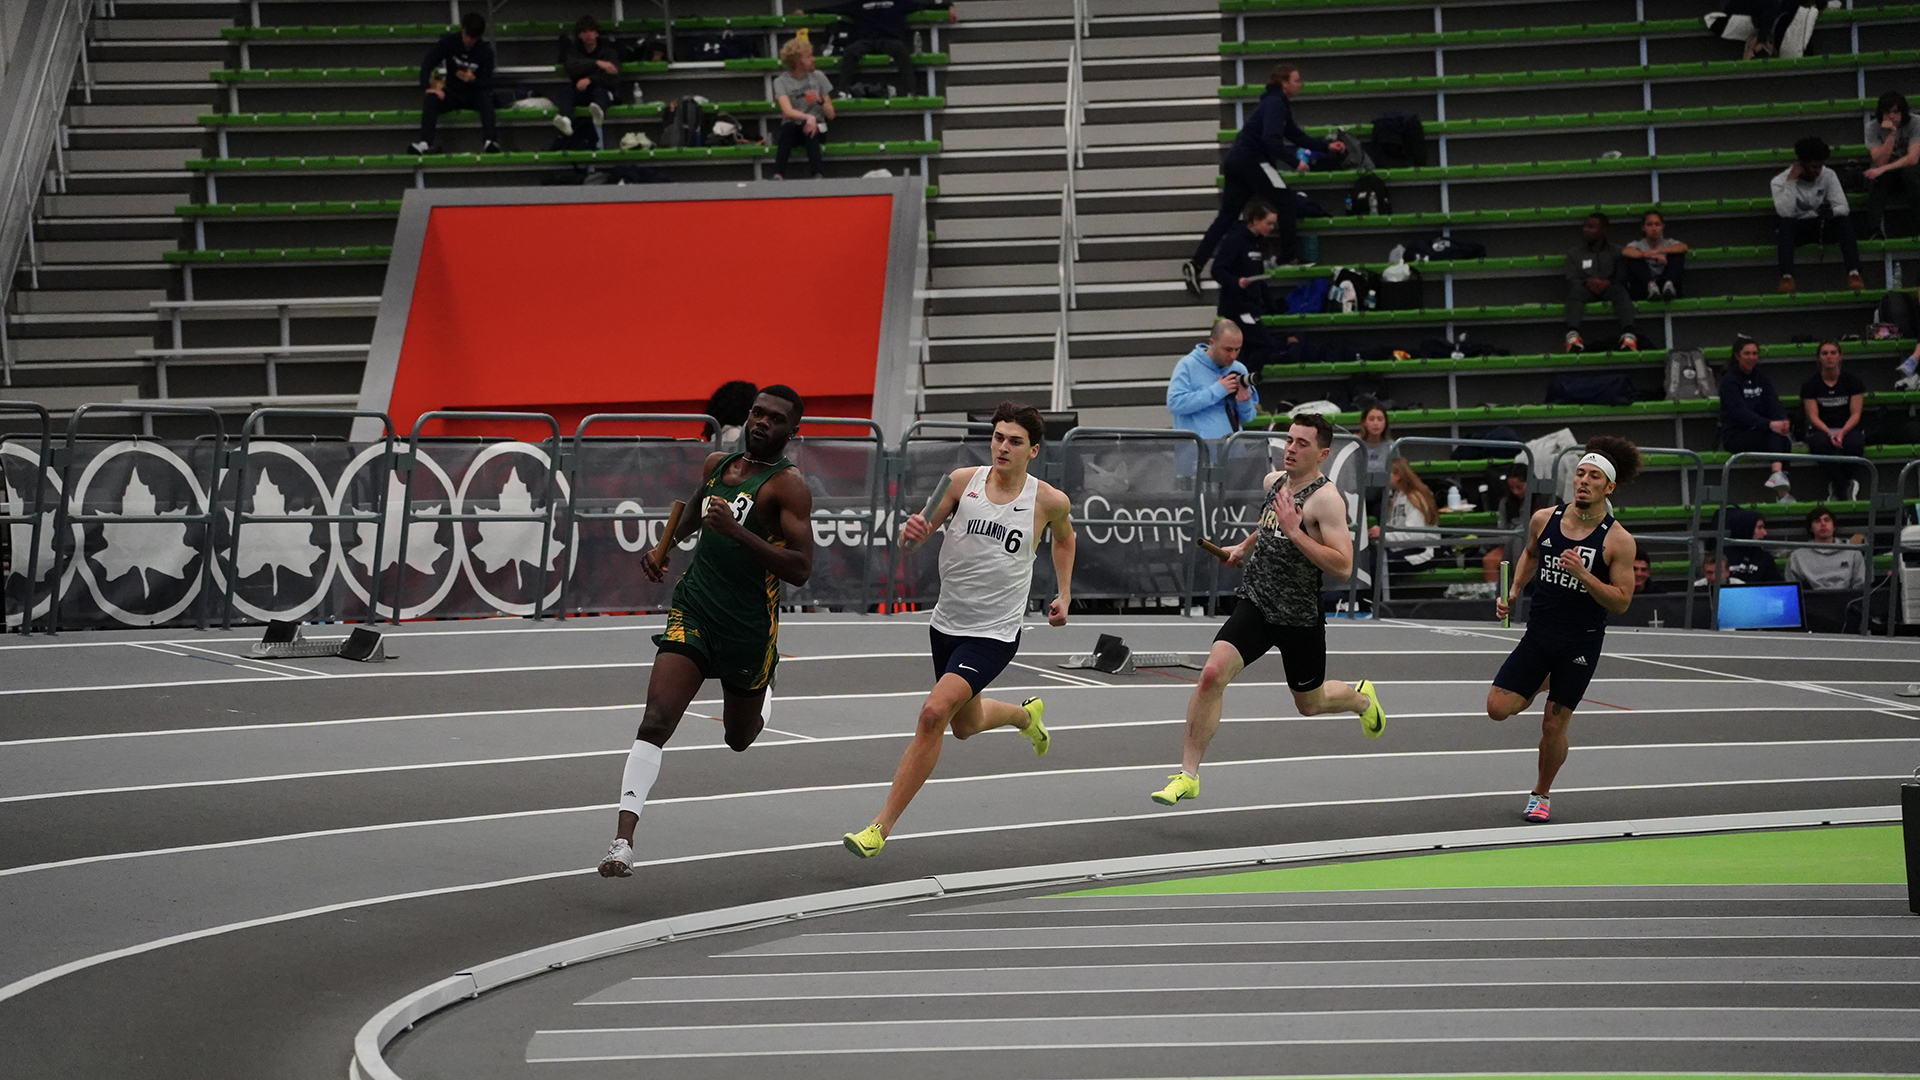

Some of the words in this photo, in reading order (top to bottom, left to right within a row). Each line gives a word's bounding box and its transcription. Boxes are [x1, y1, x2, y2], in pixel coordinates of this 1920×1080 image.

[734, 496, 748, 522] 3
[966, 519, 1007, 543] VILLANOV
[1004, 529, 1023, 553] 6
